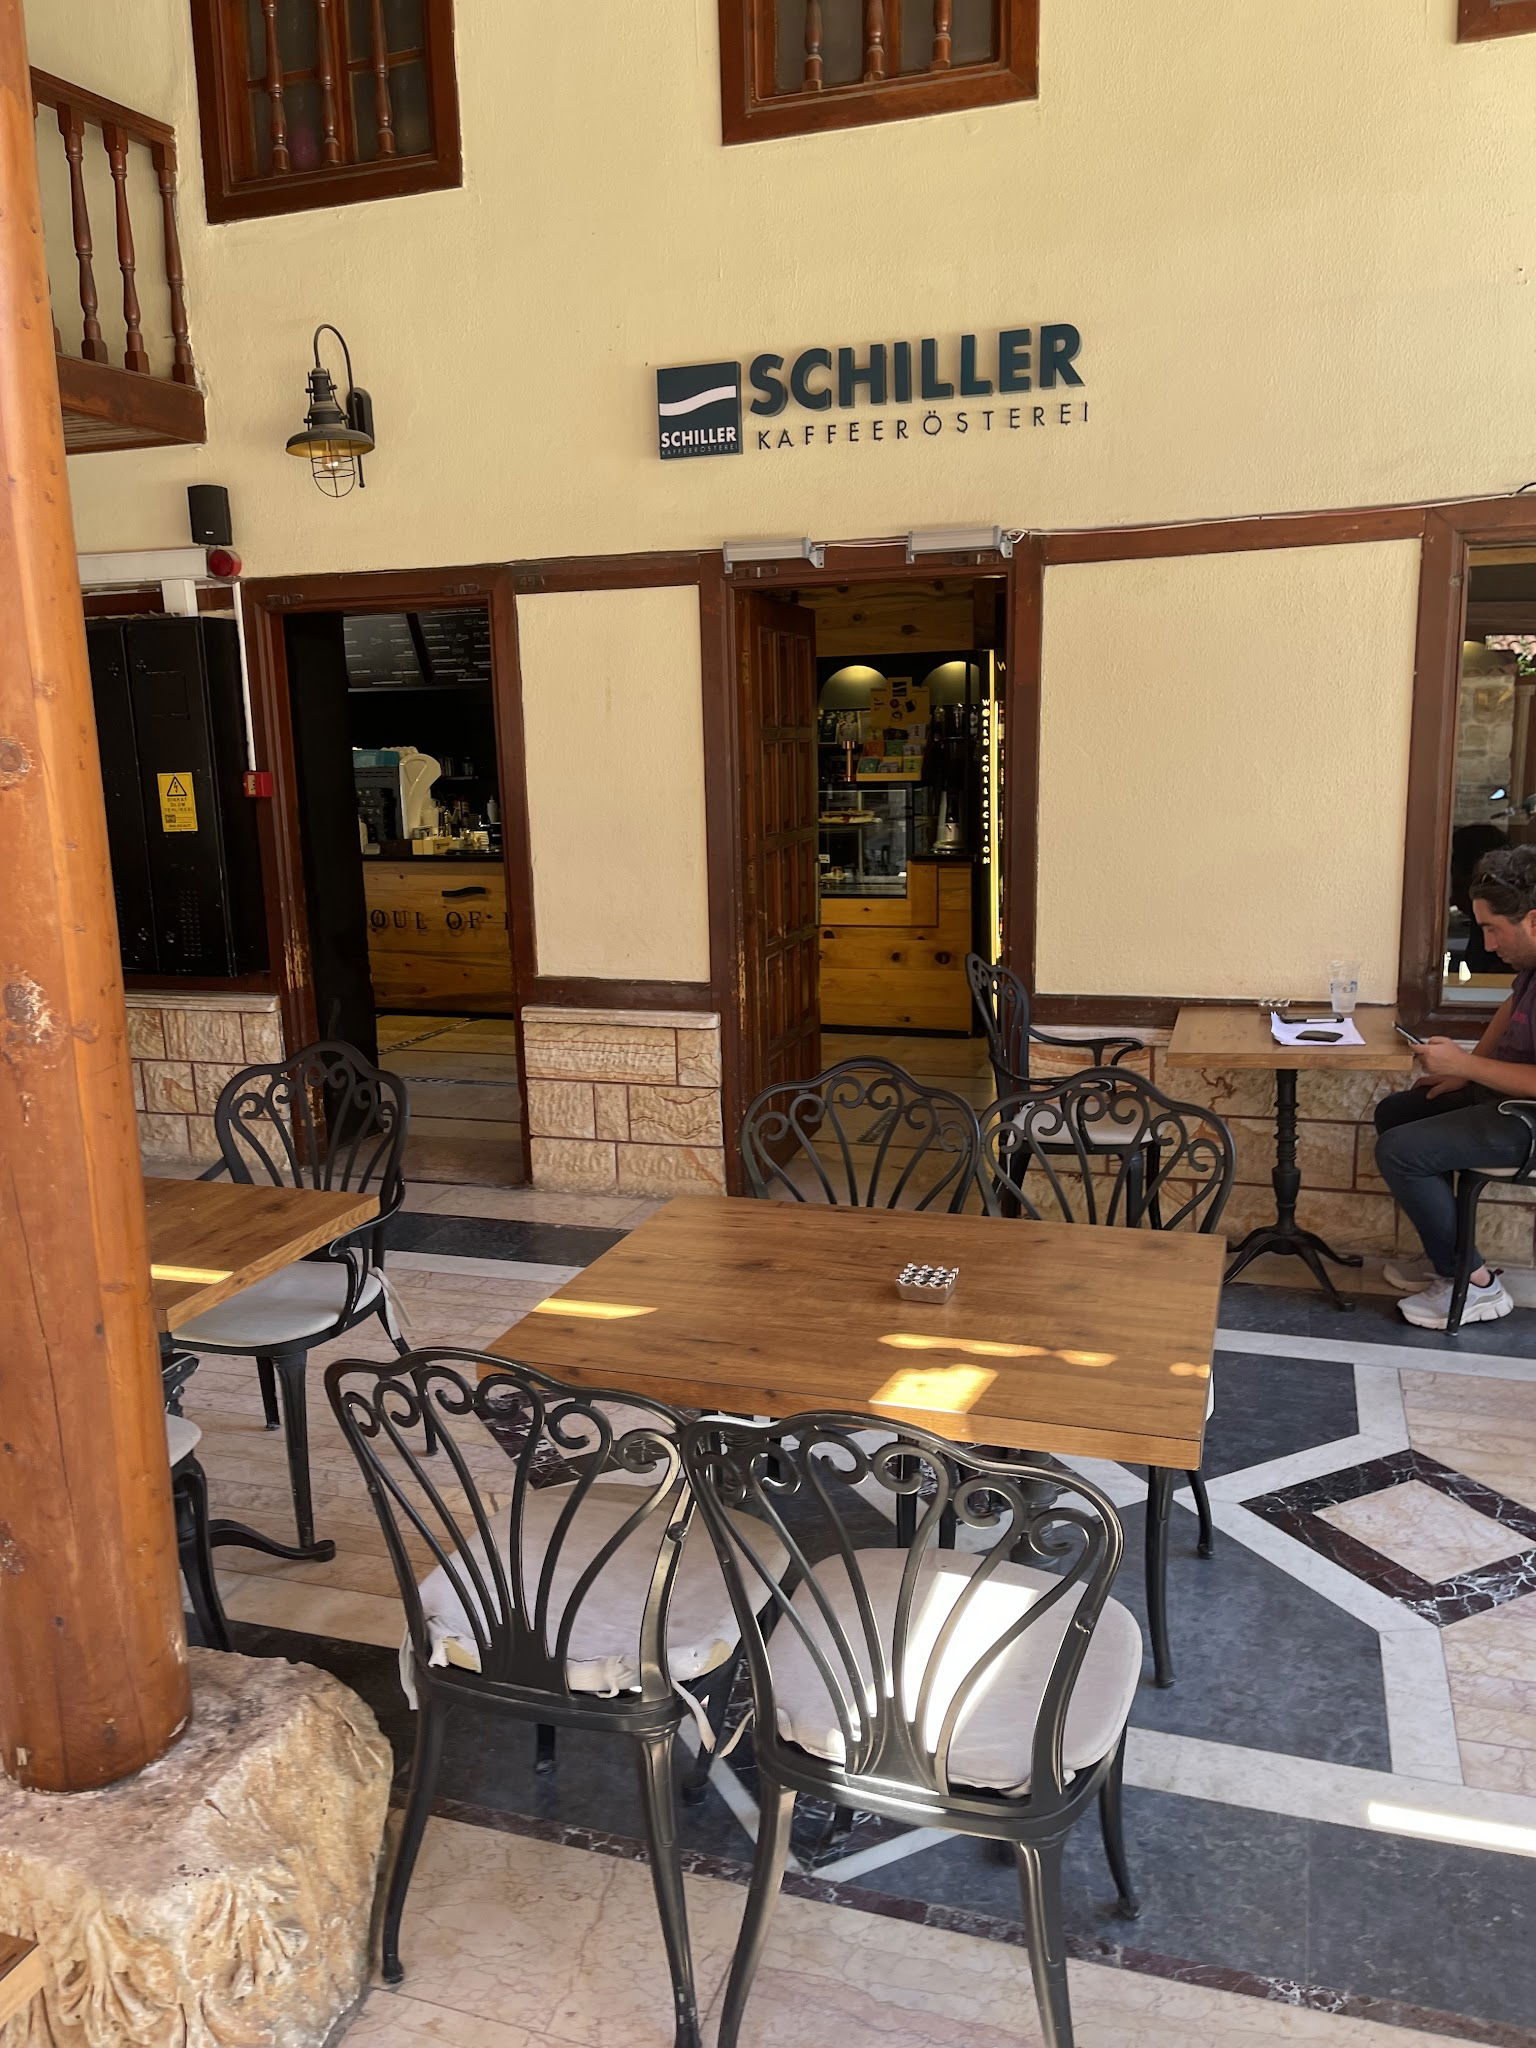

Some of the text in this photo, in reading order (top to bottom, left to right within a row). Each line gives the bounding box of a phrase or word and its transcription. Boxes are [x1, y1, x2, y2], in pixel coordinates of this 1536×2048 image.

[749, 323, 1085, 417] SCHILLER
[661, 426, 737, 448] SCHILLER
[758, 402, 1089, 450] KAFFEERÖSTEREI
[370, 909, 428, 930] OUL
[446, 911, 482, 929] OF
